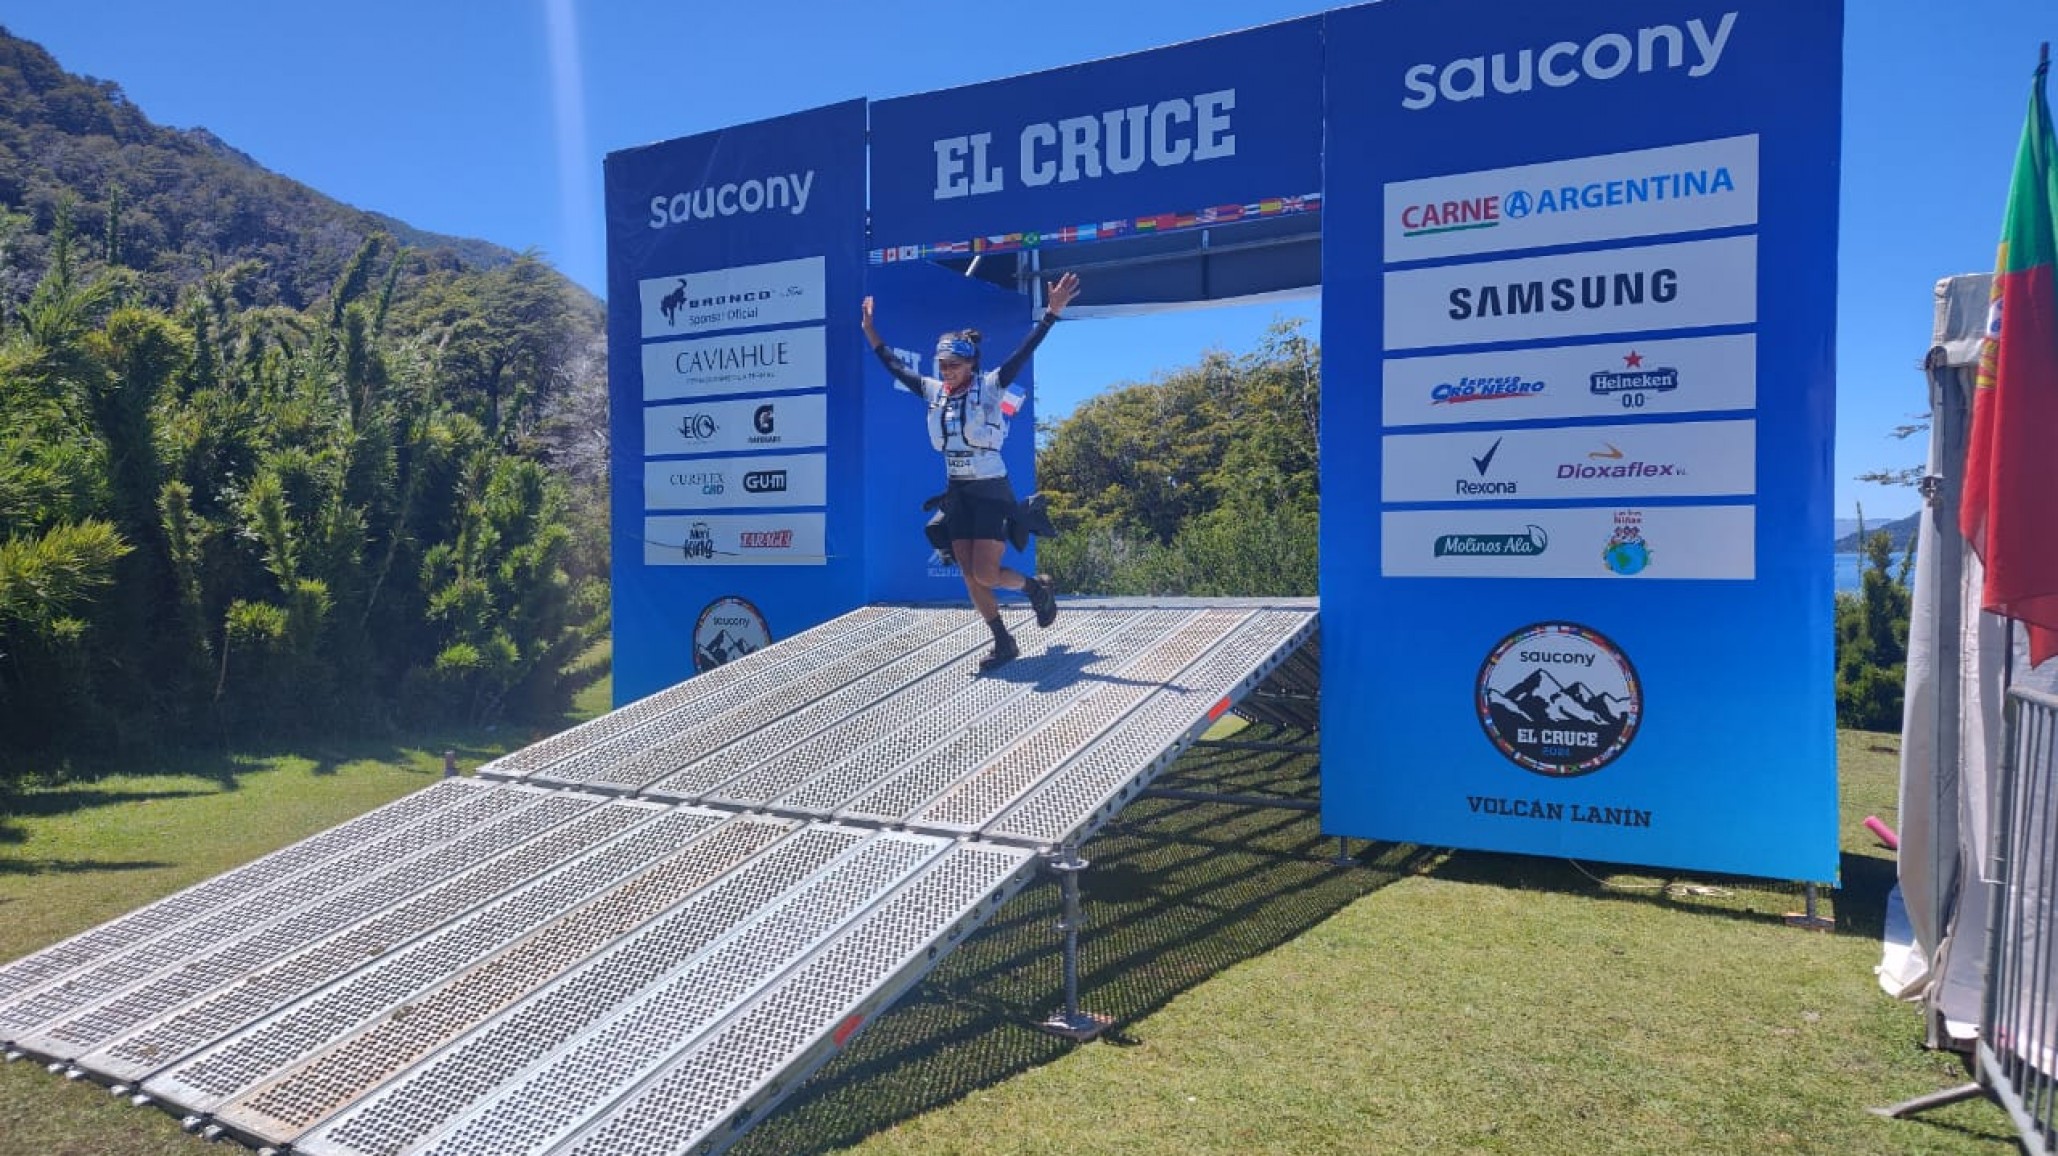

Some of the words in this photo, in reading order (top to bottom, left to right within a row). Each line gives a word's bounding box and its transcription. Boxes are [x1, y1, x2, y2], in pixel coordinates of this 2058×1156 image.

[1402, 11, 1738, 110] saucony
[933, 131, 1003, 201] EL
[1020, 88, 1236, 188] CRUCE
[649, 170, 814, 229] saucony
[1402, 196, 1500, 230] CARNE
[1537, 167, 1734, 214] ARGENTINA
[689, 290, 771, 308] BRONCO
[1449, 268, 1678, 320] SAMSUNG
[676, 341, 790, 375] CAVIAHUE
[1481, 380, 1545, 394] NEGRO
[1595, 374, 1672, 389] Heineken
[1556, 461, 1674, 480] Dioxaflex
[1456, 479, 1516, 495] Rexona
[1444, 538, 1501, 554] Molinos
[1502, 537, 1533, 554] Ala
[713, 615, 750, 628] saucony
[1520, 650, 1596, 667] saucony
[1517, 728, 1537, 743] EL
[1541, 729, 1598, 747] CRUCE
[1466, 796, 1564, 821] VOLCÁN
[1570, 803, 1652, 828] LANÍN
